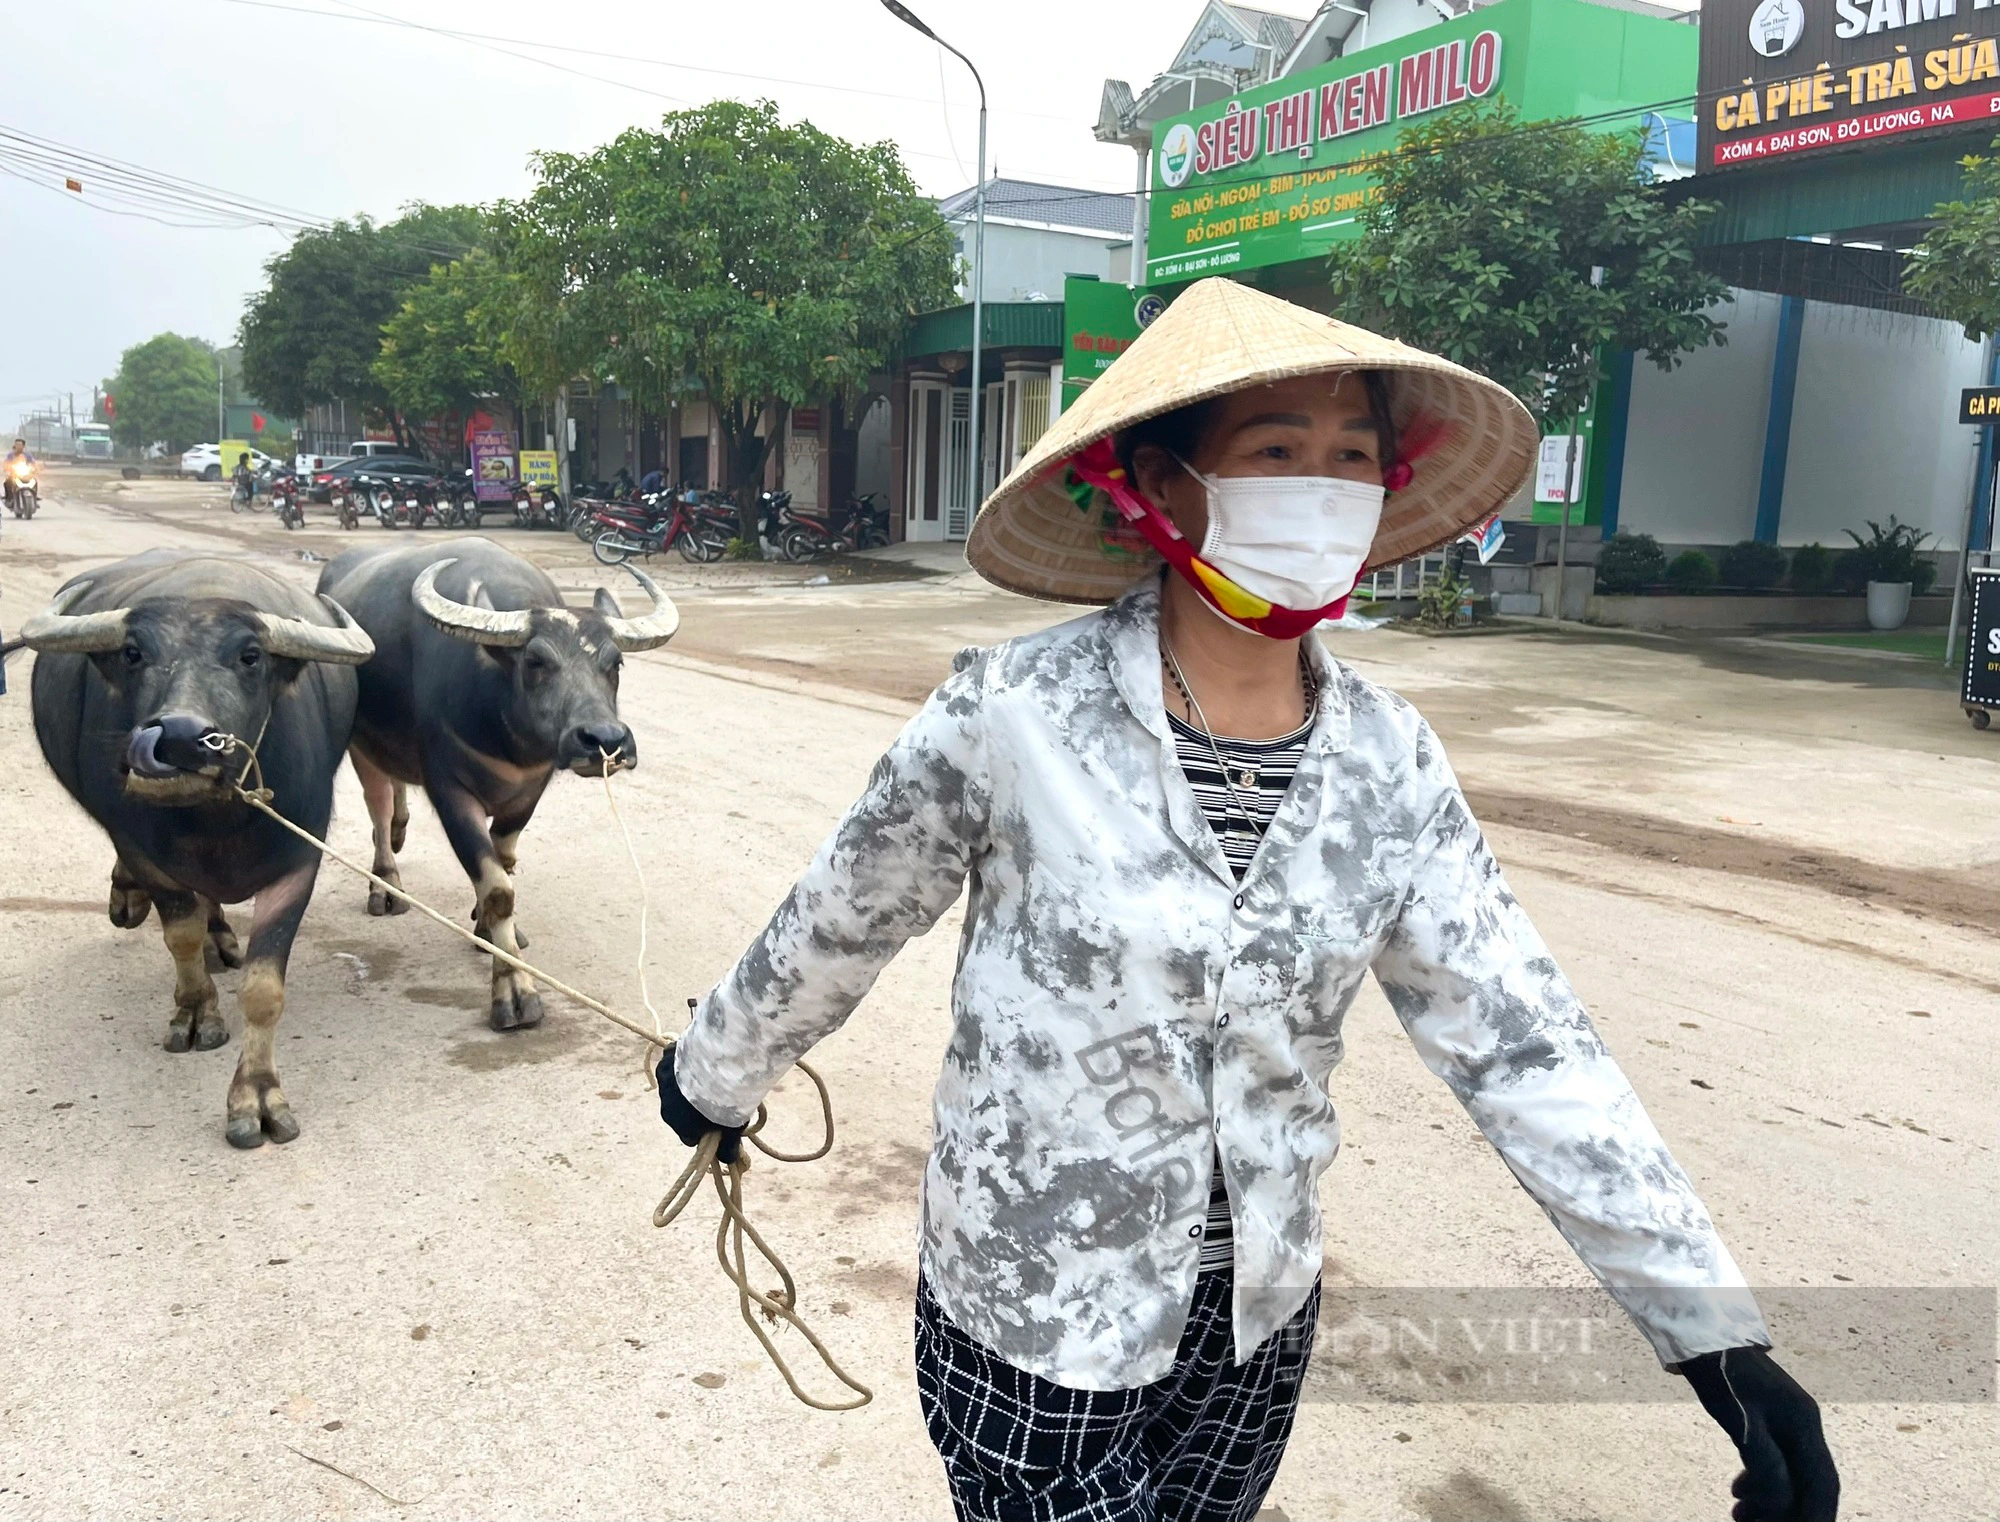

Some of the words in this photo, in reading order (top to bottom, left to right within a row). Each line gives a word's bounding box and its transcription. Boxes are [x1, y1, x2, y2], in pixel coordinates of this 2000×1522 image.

[1195, 101, 1260, 174] SIÊU
[1264, 88, 1315, 160] THỊ
[1318, 63, 1394, 141] KEN
[1397, 30, 1502, 118] MILO
[1716, 77, 1760, 131] CÀ
[1923, 33, 2000, 91] SỮA
[1721, 141, 1752, 160] XÓM
[1755, 140, 1767, 155] 4,
[1770, 134, 1794, 152] ĐẠI
[1798, 126, 1833, 146] SƠN,
[1837, 119, 1860, 138] ĐÔ
[1864, 110, 1925, 134] LƯƠNG,
[1931, 104, 1954, 121] NA
[1171, 199, 1191, 219] SỮA
[1194, 192, 1214, 215] NỘI
[1220, 183, 1261, 207] NGOẠI
[1186, 218, 1205, 244] ĐỒ
[1206, 218, 1237, 239] CHƠI
[1239, 208, 1260, 232] TRẺ
[1262, 209, 1280, 228] EM
[1289, 194, 1309, 222] ĐỒ
[1312, 196, 1331, 216] SƠ
[1334, 189, 1366, 212] SINH
[1969, 394, 1985, 416] CÀ
